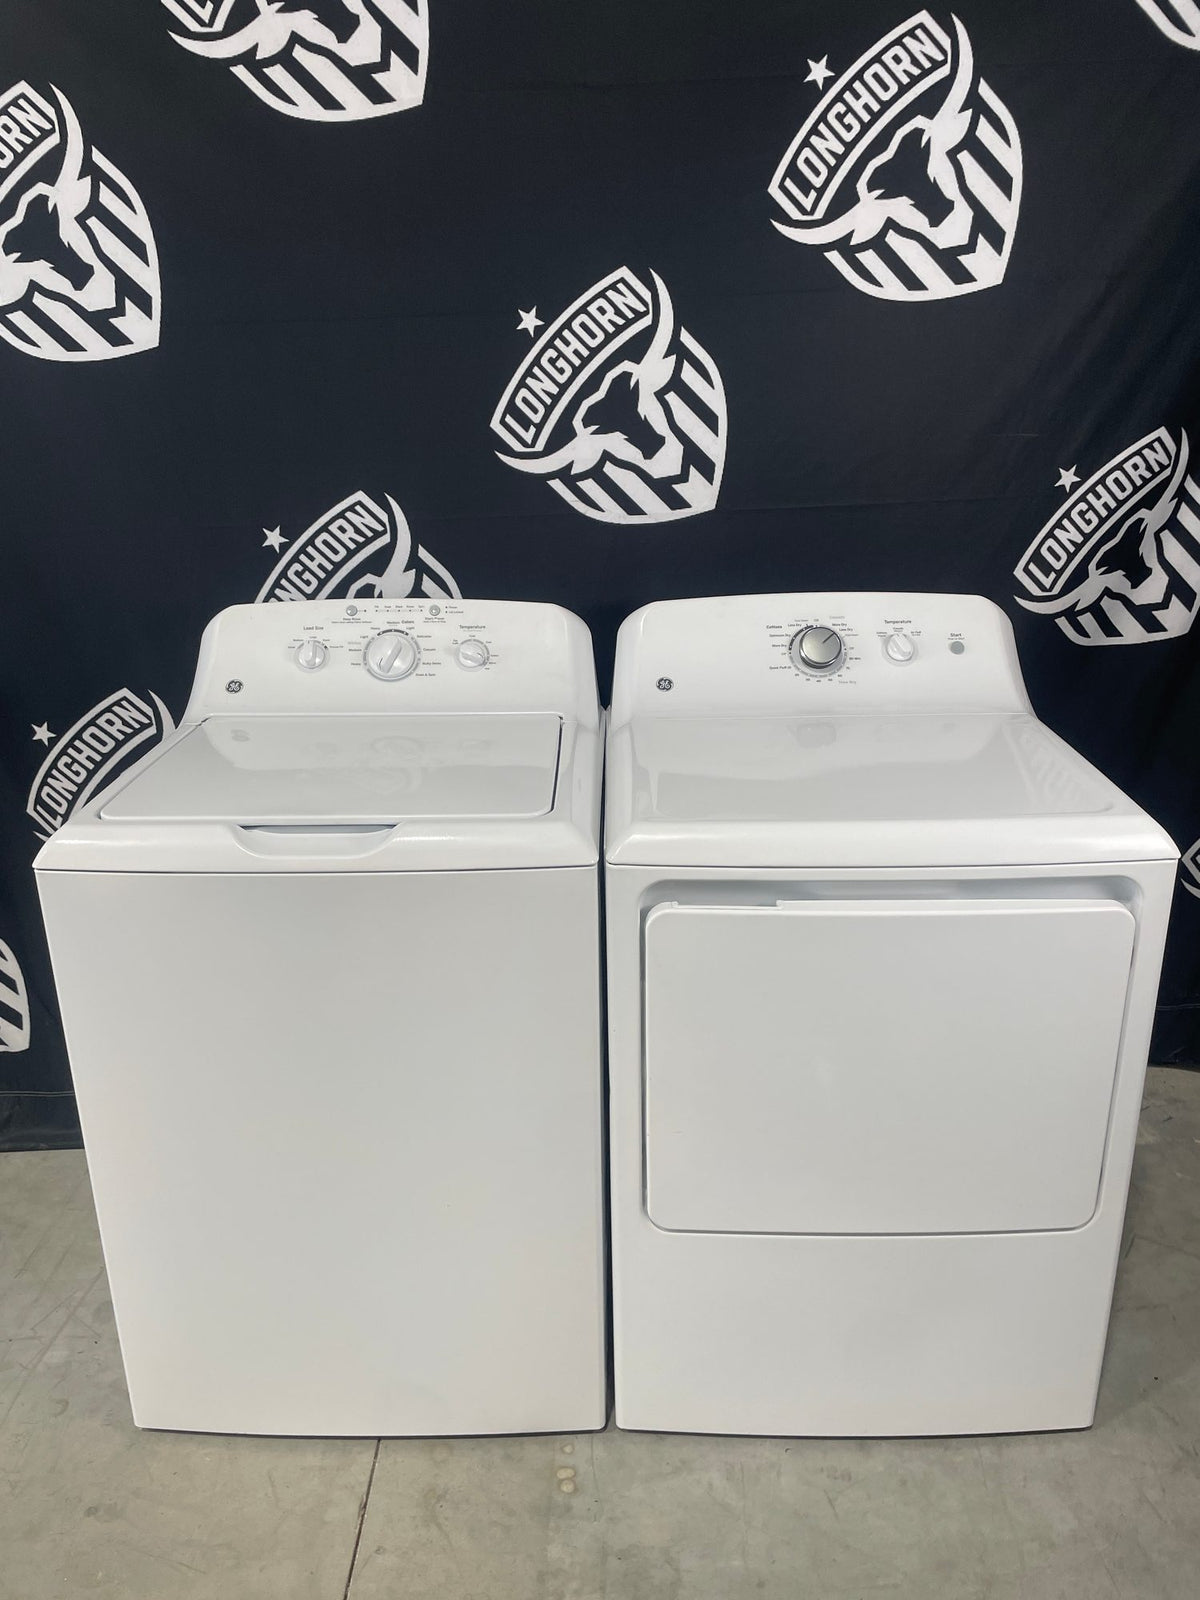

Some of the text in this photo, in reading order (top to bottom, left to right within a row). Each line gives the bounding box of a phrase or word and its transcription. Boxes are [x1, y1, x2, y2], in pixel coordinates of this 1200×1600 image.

[783, 28, 945, 212] LONGHORN
[504, 282, 647, 445] LONGHORN
[267, 504, 385, 603] NGHORN
[1027, 440, 1170, 590] LONGHORN
[36, 700, 151, 829] LONGHORN
